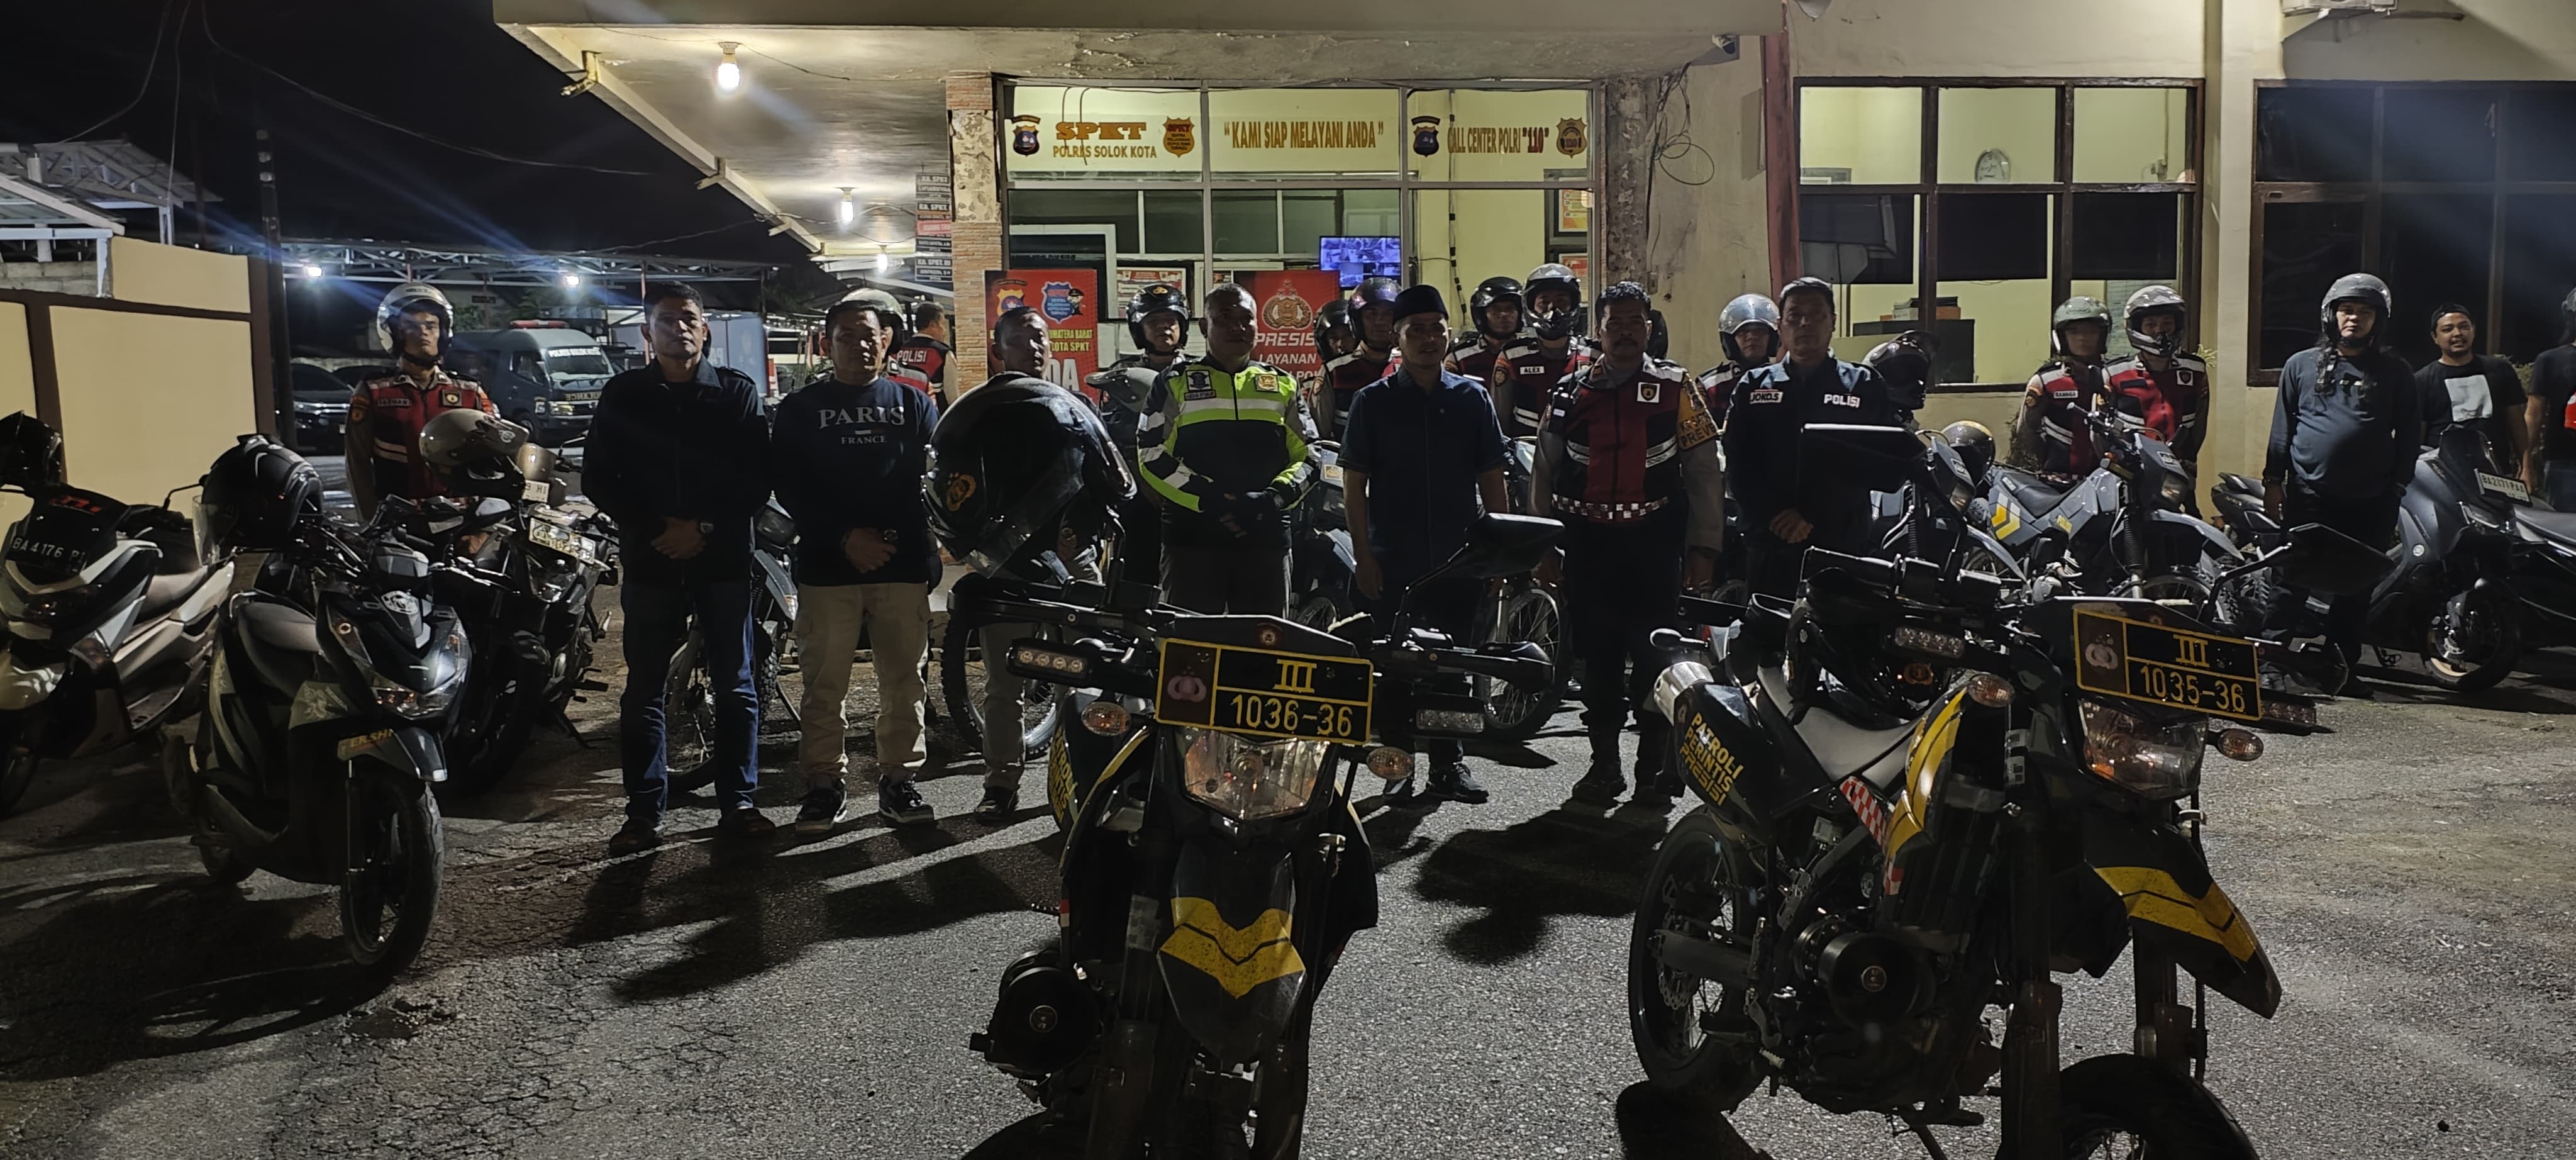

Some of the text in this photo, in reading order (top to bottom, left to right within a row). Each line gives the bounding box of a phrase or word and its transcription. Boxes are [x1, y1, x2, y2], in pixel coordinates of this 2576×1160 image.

[1055, 121, 1146, 140] SPKT
[1264, 121, 1287, 148] SIAP
[1291, 121, 1343, 148] MELAYANI
[1448, 127, 1466, 153] CALL
[1468, 127, 1496, 153] CENTER
[1498, 127, 1521, 153] POLRI
[1053, 145, 1158, 158] POLRES SOLOK KOTA
[896, 350, 928, 363] POLISI
[1070, 342, 1090, 352] SPKT
[1258, 353, 1317, 364] LAYANAN
[1823, 393, 1861, 408] POLISI
[818, 406, 906, 429] PARIS
[840, 435, 886, 445] FRANCE
[11, 537, 30, 551] BA
[30, 542, 64, 558] 4176
[2172, 633, 2211, 668] III
[1272, 658, 1318, 694] III
[2140, 665, 2246, 713] 1035-36
[1230, 694, 1353, 737] 1036-36
[1690, 711, 1745, 780] PATROLI
[1684, 725, 1734, 793] PERINTIS
[1679, 742, 1726, 806] PRESISI
